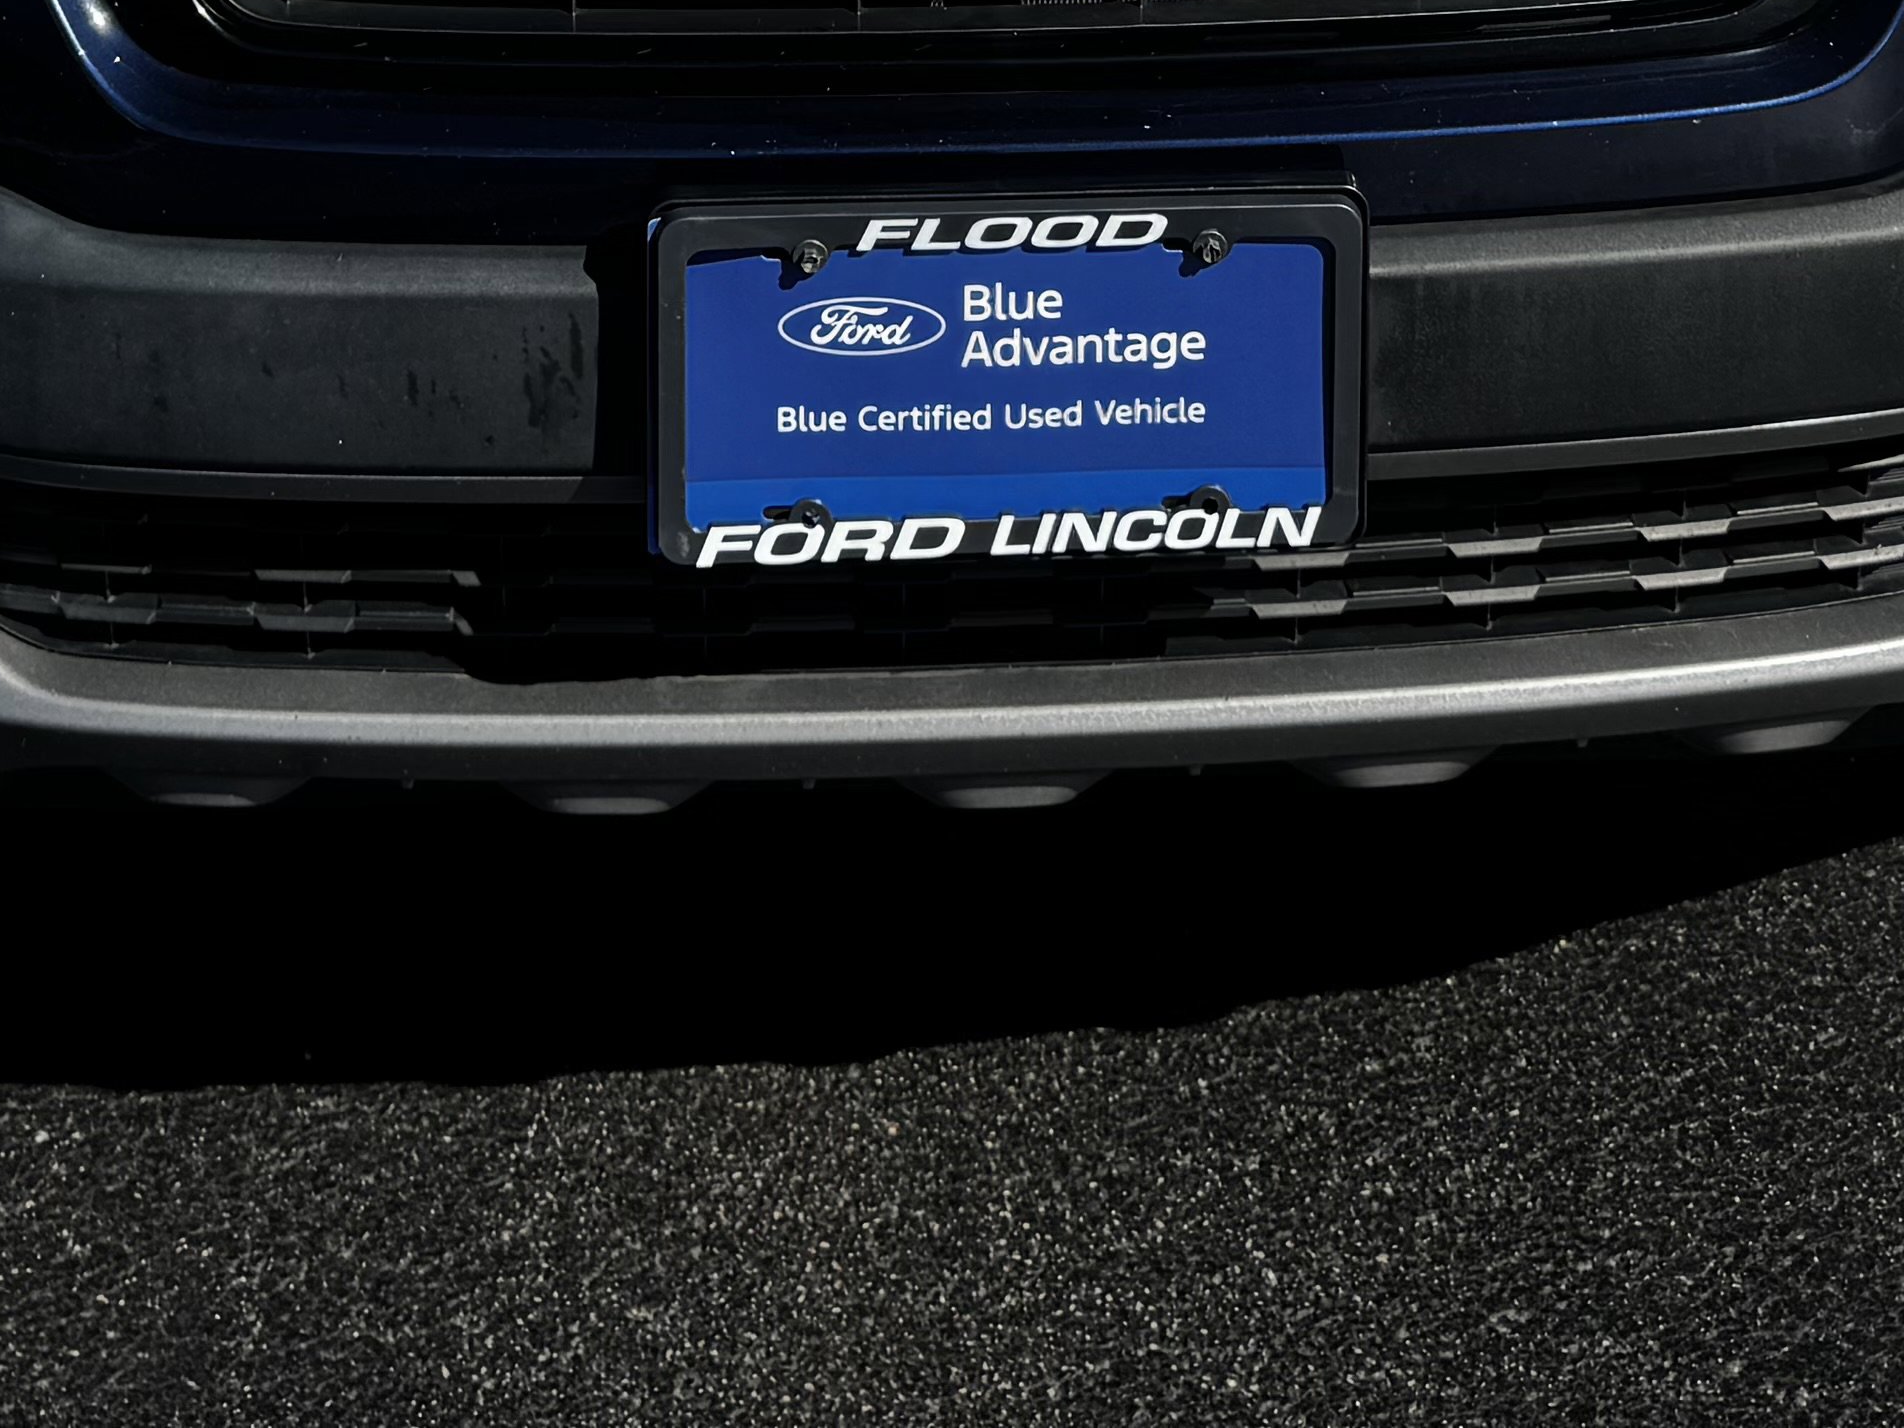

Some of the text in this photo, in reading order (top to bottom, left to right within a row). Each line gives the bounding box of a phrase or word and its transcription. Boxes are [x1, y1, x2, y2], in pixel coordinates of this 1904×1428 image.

[855, 211, 1170, 253] FLOOD
[963, 282, 1063, 322] Blue
[810, 304, 914, 347] Ford
[961, 327, 1207, 370] Advantage
[777, 396, 1206, 433] Blue Certified Used Vehicle
[695, 506, 1322, 569] FORD LINCOLN
